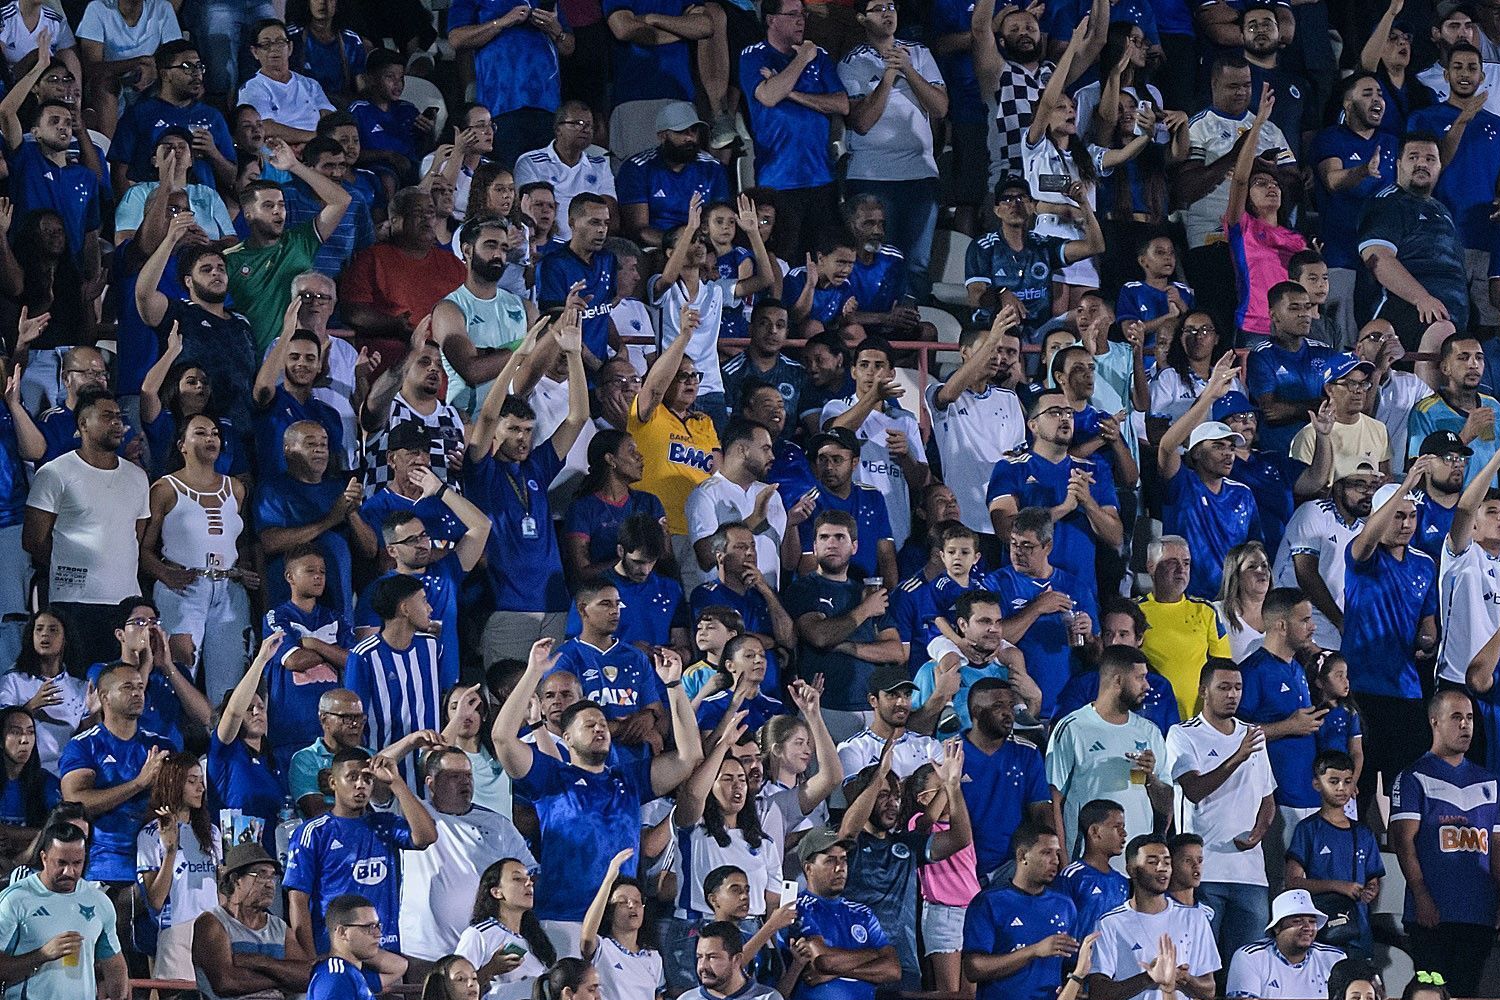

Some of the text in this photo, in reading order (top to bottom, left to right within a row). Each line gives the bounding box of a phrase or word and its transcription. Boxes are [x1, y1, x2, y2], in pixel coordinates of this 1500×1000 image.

[1012, 287, 1046, 301] etfair
[868, 461, 900, 478] betfa
[356, 863, 380, 880] BH
